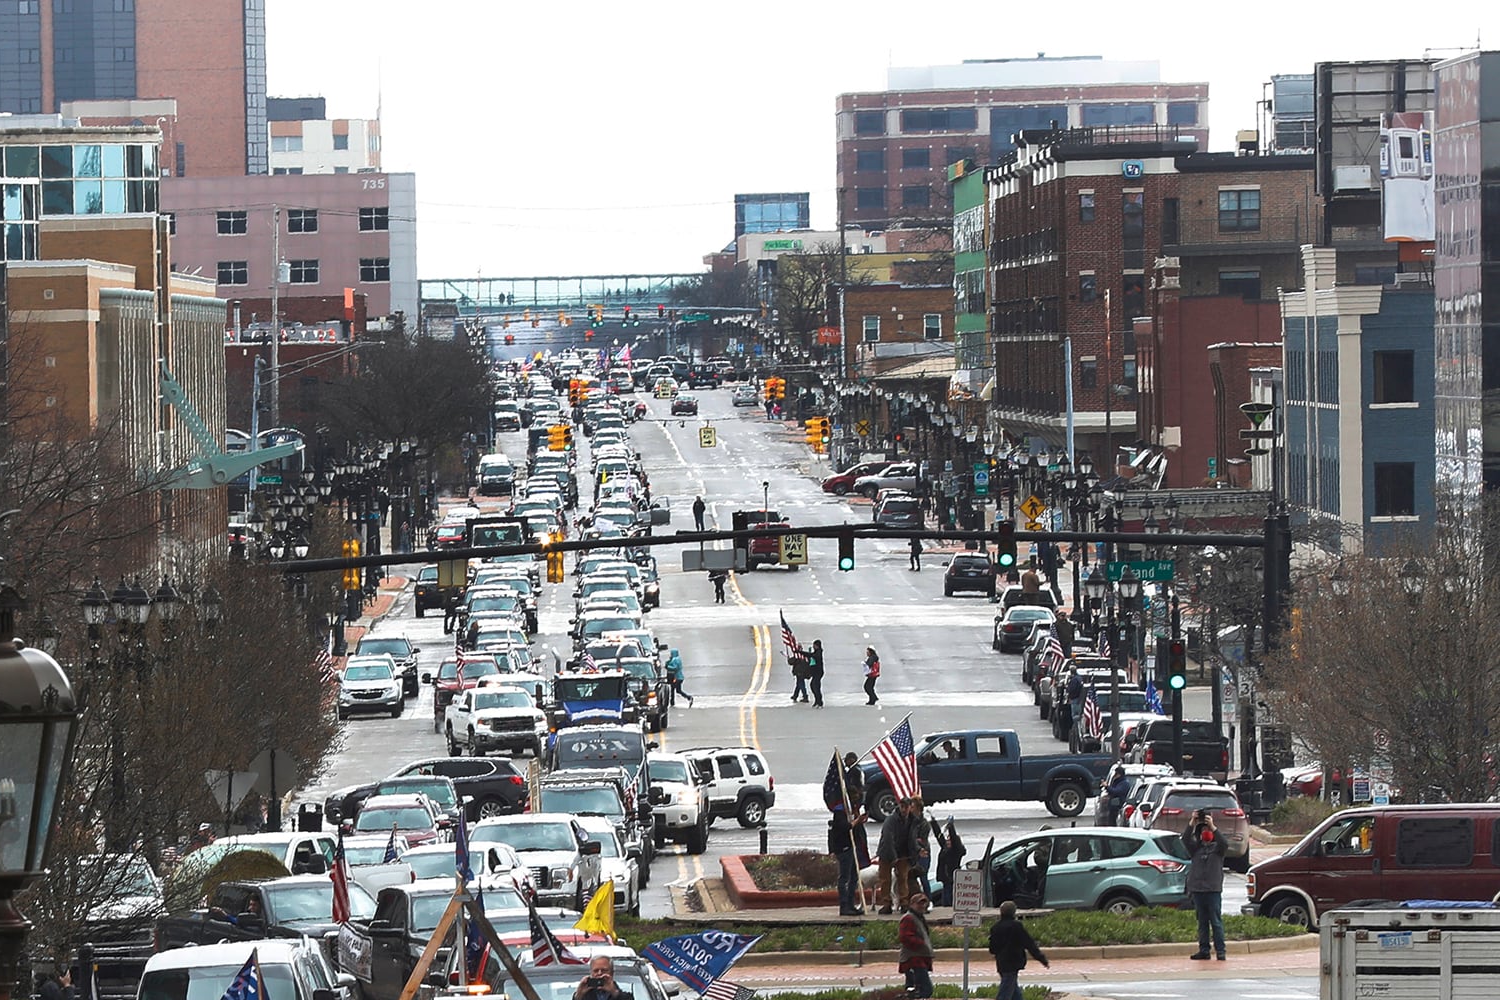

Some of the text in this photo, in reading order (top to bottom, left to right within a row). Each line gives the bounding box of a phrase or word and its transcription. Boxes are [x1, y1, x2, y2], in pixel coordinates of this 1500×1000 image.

[362, 178, 385, 190] 735
[785, 543, 803, 551] WAY
[1158, 562, 1171, 571] Ave
